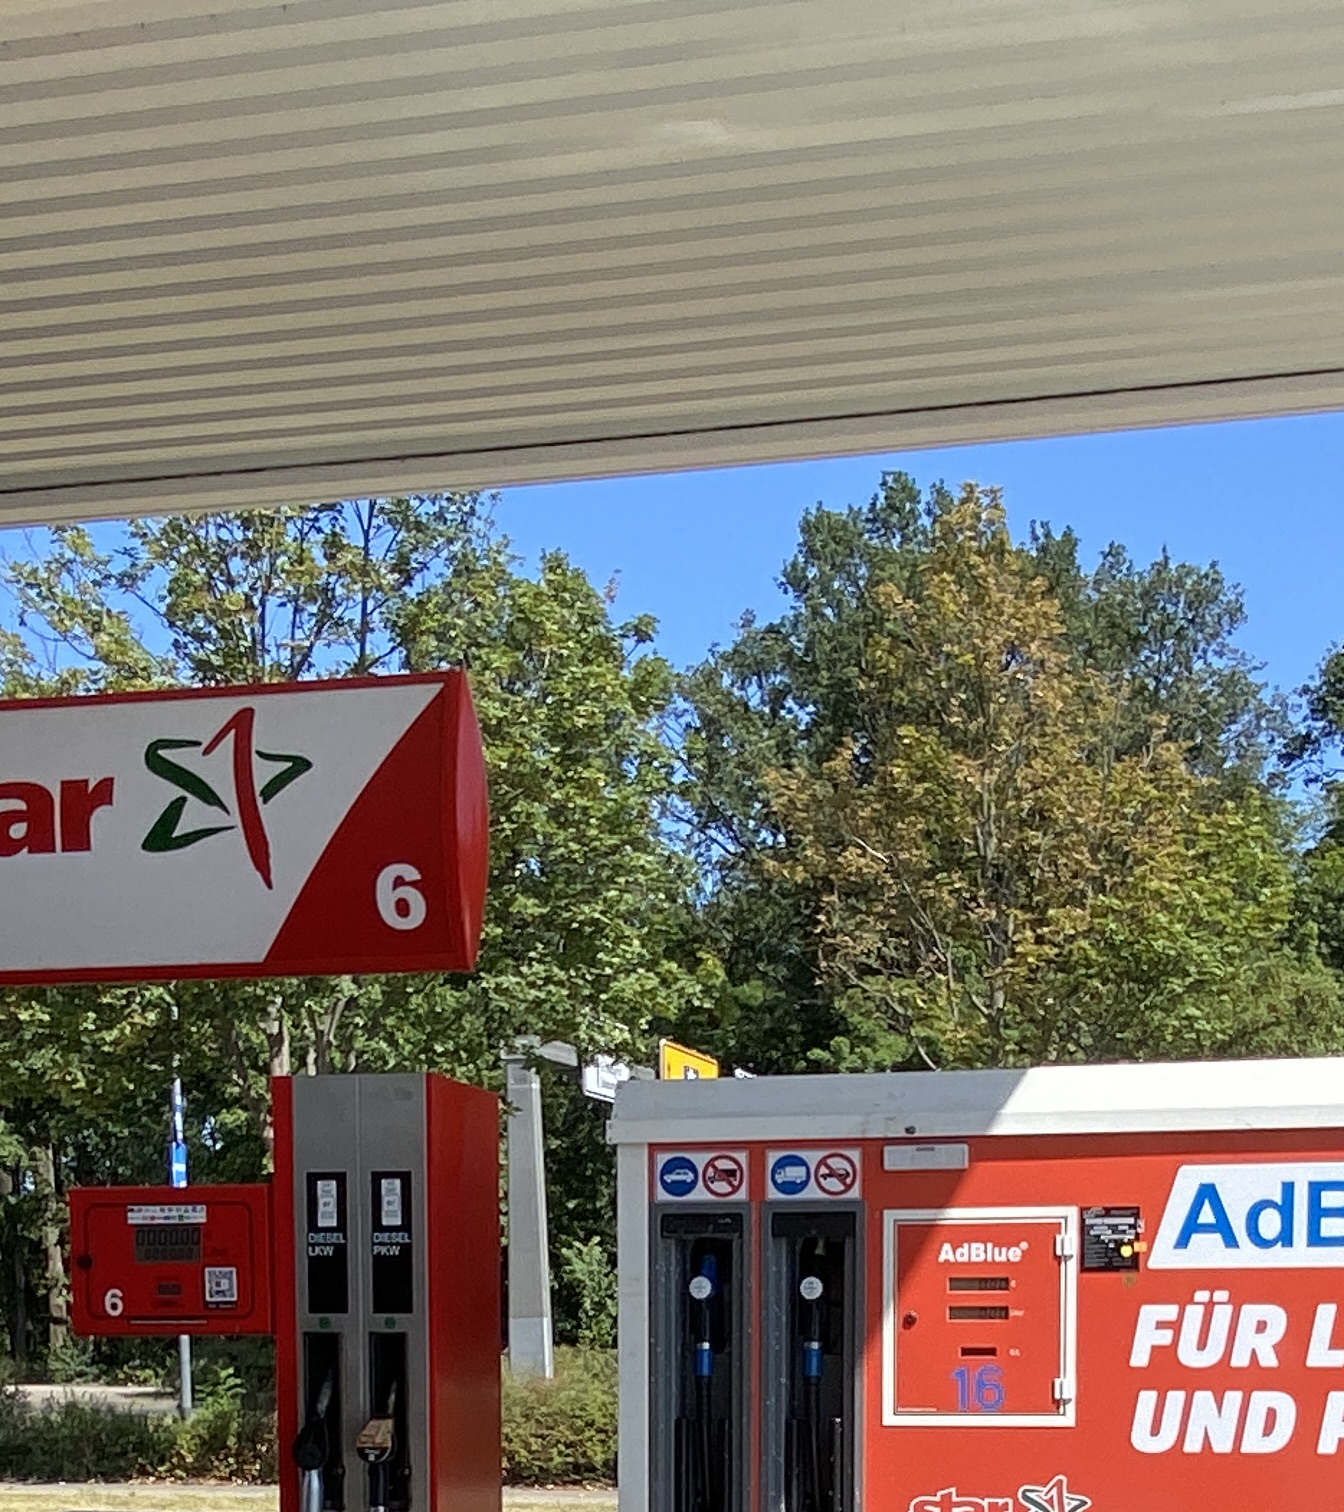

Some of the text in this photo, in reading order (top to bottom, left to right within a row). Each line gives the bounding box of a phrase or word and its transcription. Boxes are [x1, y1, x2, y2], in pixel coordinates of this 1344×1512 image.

[374, 863, 428, 932] 6
[308, 1232, 346, 1244] DIESEL
[372, 1232, 412, 1244] DIESEL
[372, 1244, 401, 1257] PKW
[104, 1288, 125, 1317] 6
[1129, 1289, 1287, 1368] FÜR
[951, 1363, 1007, 1413] 16
[1130, 1390, 1301, 1455] UND
